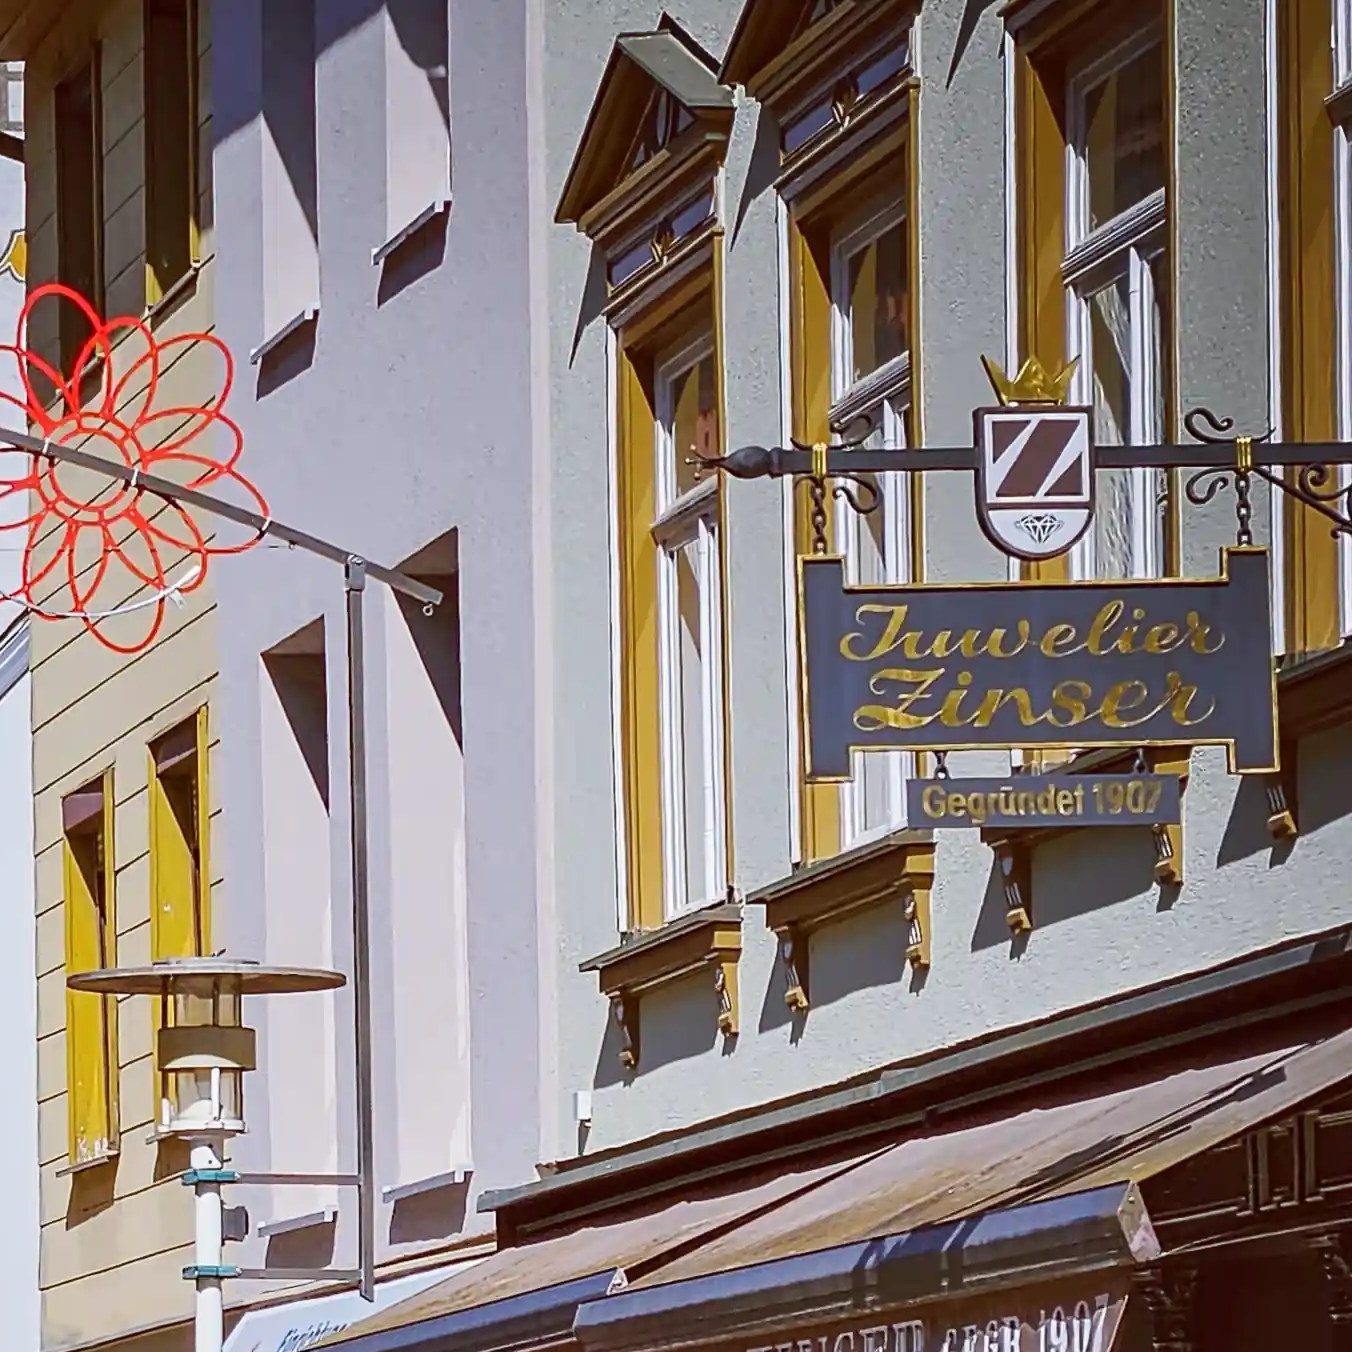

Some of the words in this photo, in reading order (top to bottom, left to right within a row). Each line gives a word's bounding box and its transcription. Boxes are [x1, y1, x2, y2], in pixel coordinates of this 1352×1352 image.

[839, 599, 1226, 660] Juwelier
[852, 667, 1216, 732] Zinser
[921, 783, 1085, 824] Gegründet
[1092, 780, 1163, 814] 1907
